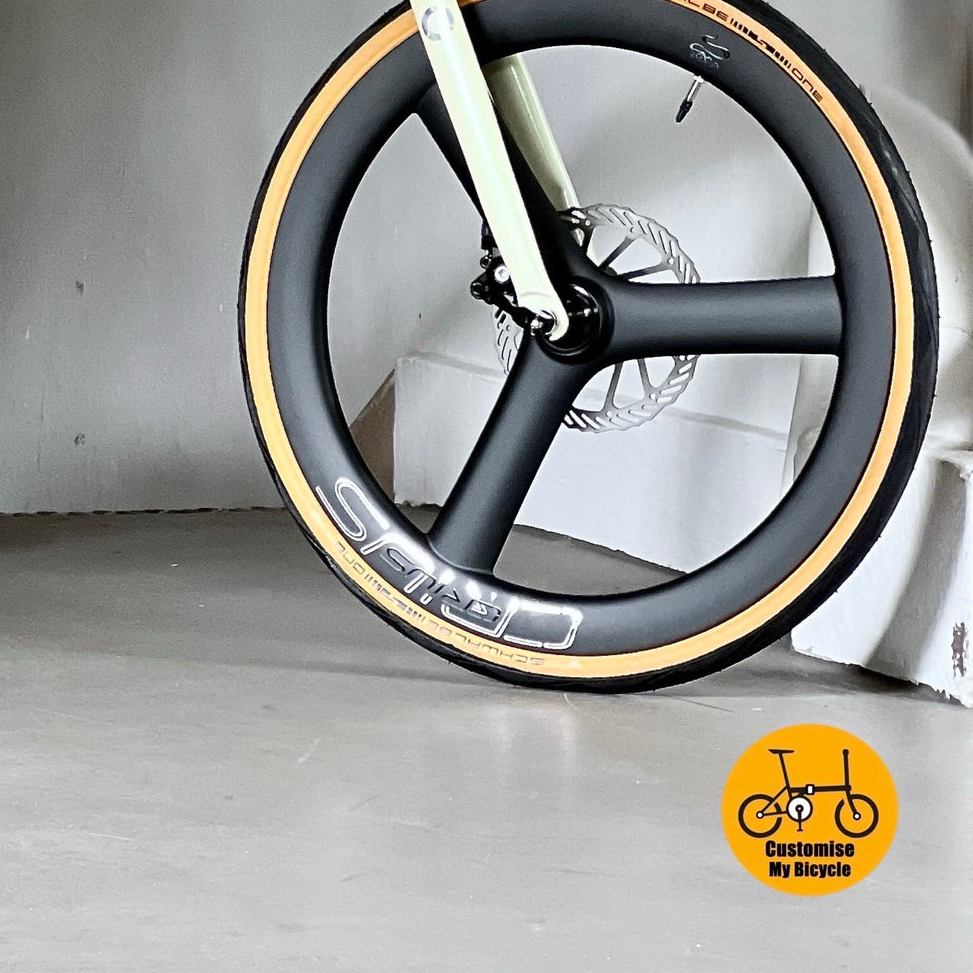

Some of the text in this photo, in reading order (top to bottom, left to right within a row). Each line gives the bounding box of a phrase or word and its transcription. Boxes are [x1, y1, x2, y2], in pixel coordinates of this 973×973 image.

[791, 67, 824, 103] ONE
[315, 477, 583, 650] CRIUS
[333, 540, 545, 667] SCHWALBE ONE
